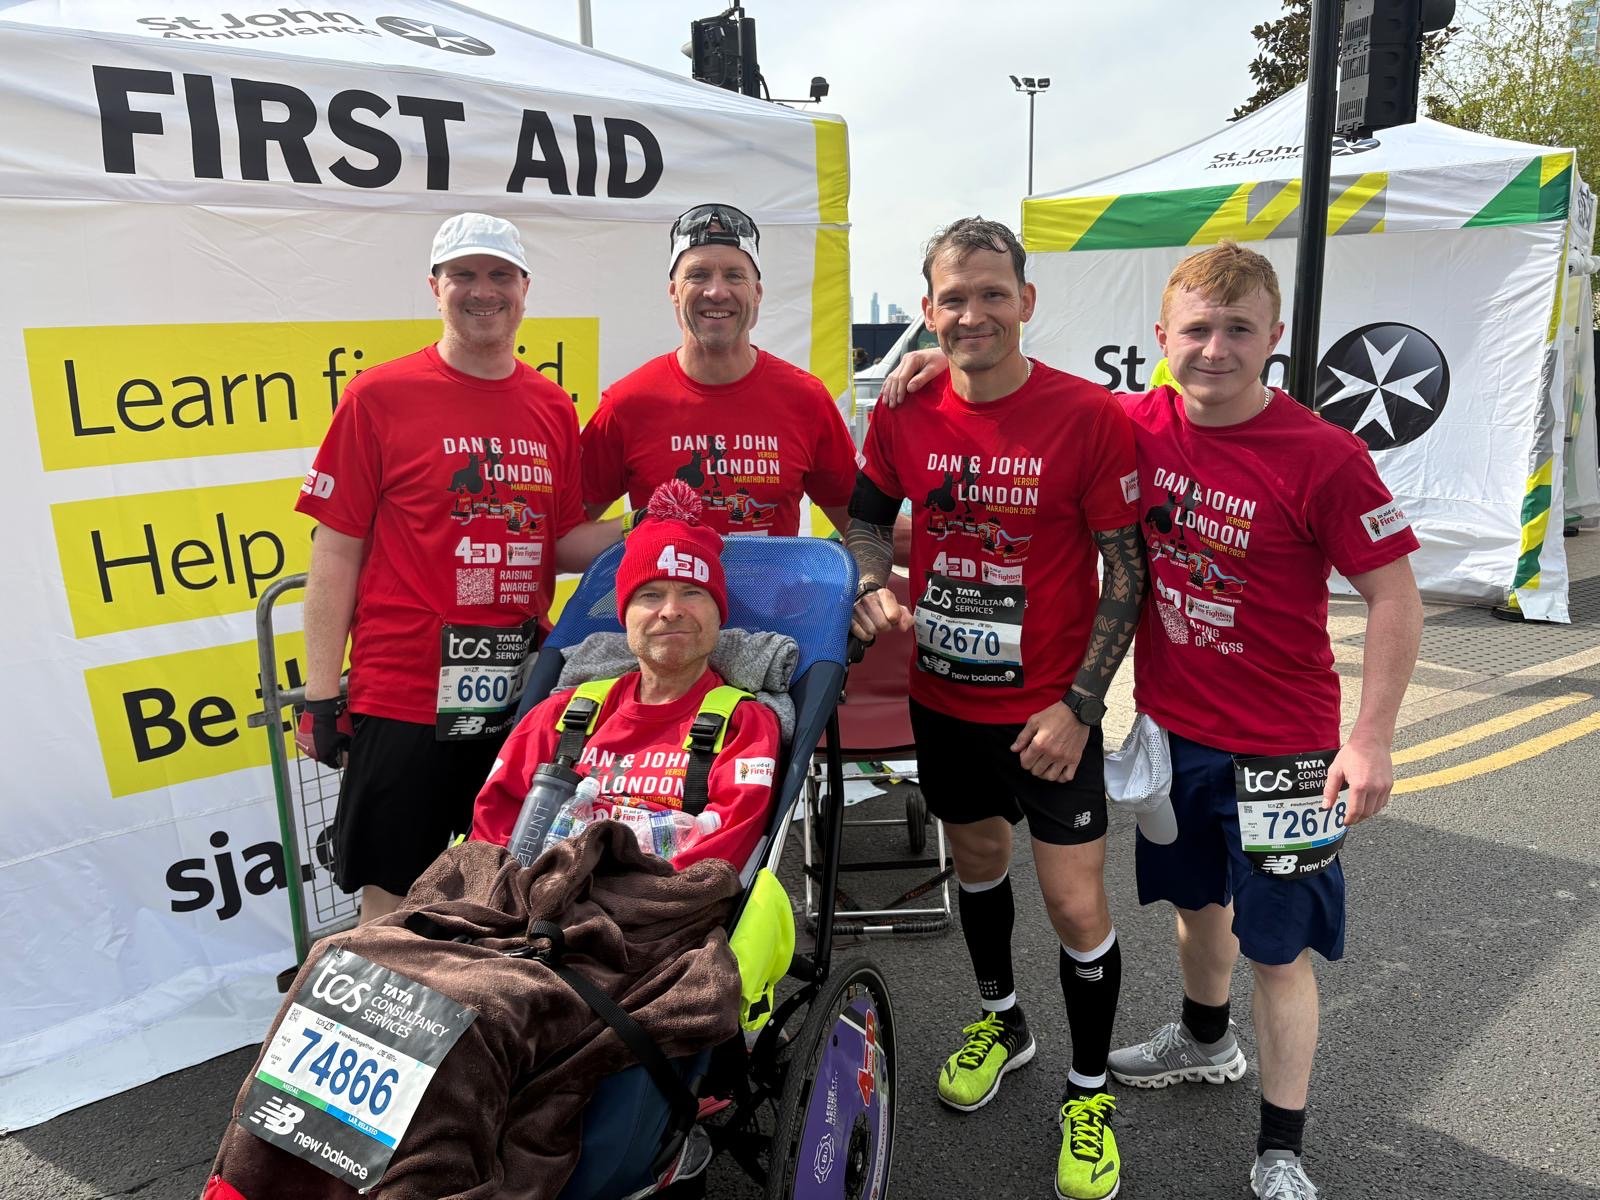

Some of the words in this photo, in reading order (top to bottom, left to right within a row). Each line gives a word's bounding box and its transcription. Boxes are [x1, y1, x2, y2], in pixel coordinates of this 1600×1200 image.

[136, 16, 213, 31] St
[218, 8, 365, 30] John
[162, 24, 382, 40] Ambulance
[92, 64, 465, 189] FIRST
[506, 108, 664, 199] AID
[1204, 154, 1304, 170] Ambulance
[1210, 151, 1239, 163] St
[1094, 344, 1146, 392] St
[63, 359, 299, 437] Learn
[443, 437, 484, 455] DAN
[491, 437, 503, 455] &
[509, 438, 548, 460] JOHN
[671, 435, 708, 451] DAN
[715, 434, 726, 450] &
[733, 434, 779, 451] JOHN
[757, 451, 779, 459] VERSUS
[927, 453, 963, 472] DAN
[969, 455, 981, 474] &
[987, 456, 1043, 476] JOHN
[484, 463, 552, 483] LONDON
[706, 459, 780, 475] LONDON
[733, 475, 765, 484] MARATHON
[1013, 477, 1039, 486] VERSUS
[1153, 467, 1190, 495] DAN
[1192, 482, 1203, 502] &
[958, 484, 1039, 506] LONDON
[985, 504, 1019, 515] MARATHON
[1174, 506, 1250, 550] LONDON
[1225, 515, 1251, 530] VERSUS
[1380, 516, 1395, 526] Fire
[91, 512, 286, 603] Help
[500, 570, 533, 580] RAISING
[500, 594, 511, 604] OF
[956, 587, 982, 597] TATA
[955, 605, 994, 615] SERVICES
[1206, 609, 1233, 620] Fighters
[448, 632, 491, 659] tcs
[496, 634, 523, 643] TATA
[925, 619, 1000, 657] 72670
[952, 671, 970, 681] new
[122, 686, 241, 763] Be
[620, 753, 635, 768] &
[1295, 759, 1326, 770] TATA
[1244, 766, 1293, 793] tcs
[520, 801, 550, 853] HUNT
[1263, 801, 1347, 840] 72678
[1299, 862, 1319, 873] new
[312, 959, 371, 1012] tcs
[381, 982, 415, 1004] TATA
[361, 1009, 413, 1039] SERVICES
[371, 996, 450, 1038] CONSULTANCY
[287, 1028, 399, 1116] 74866
[293, 1131, 323, 1153] new
[320, 1142, 369, 1180] balance
